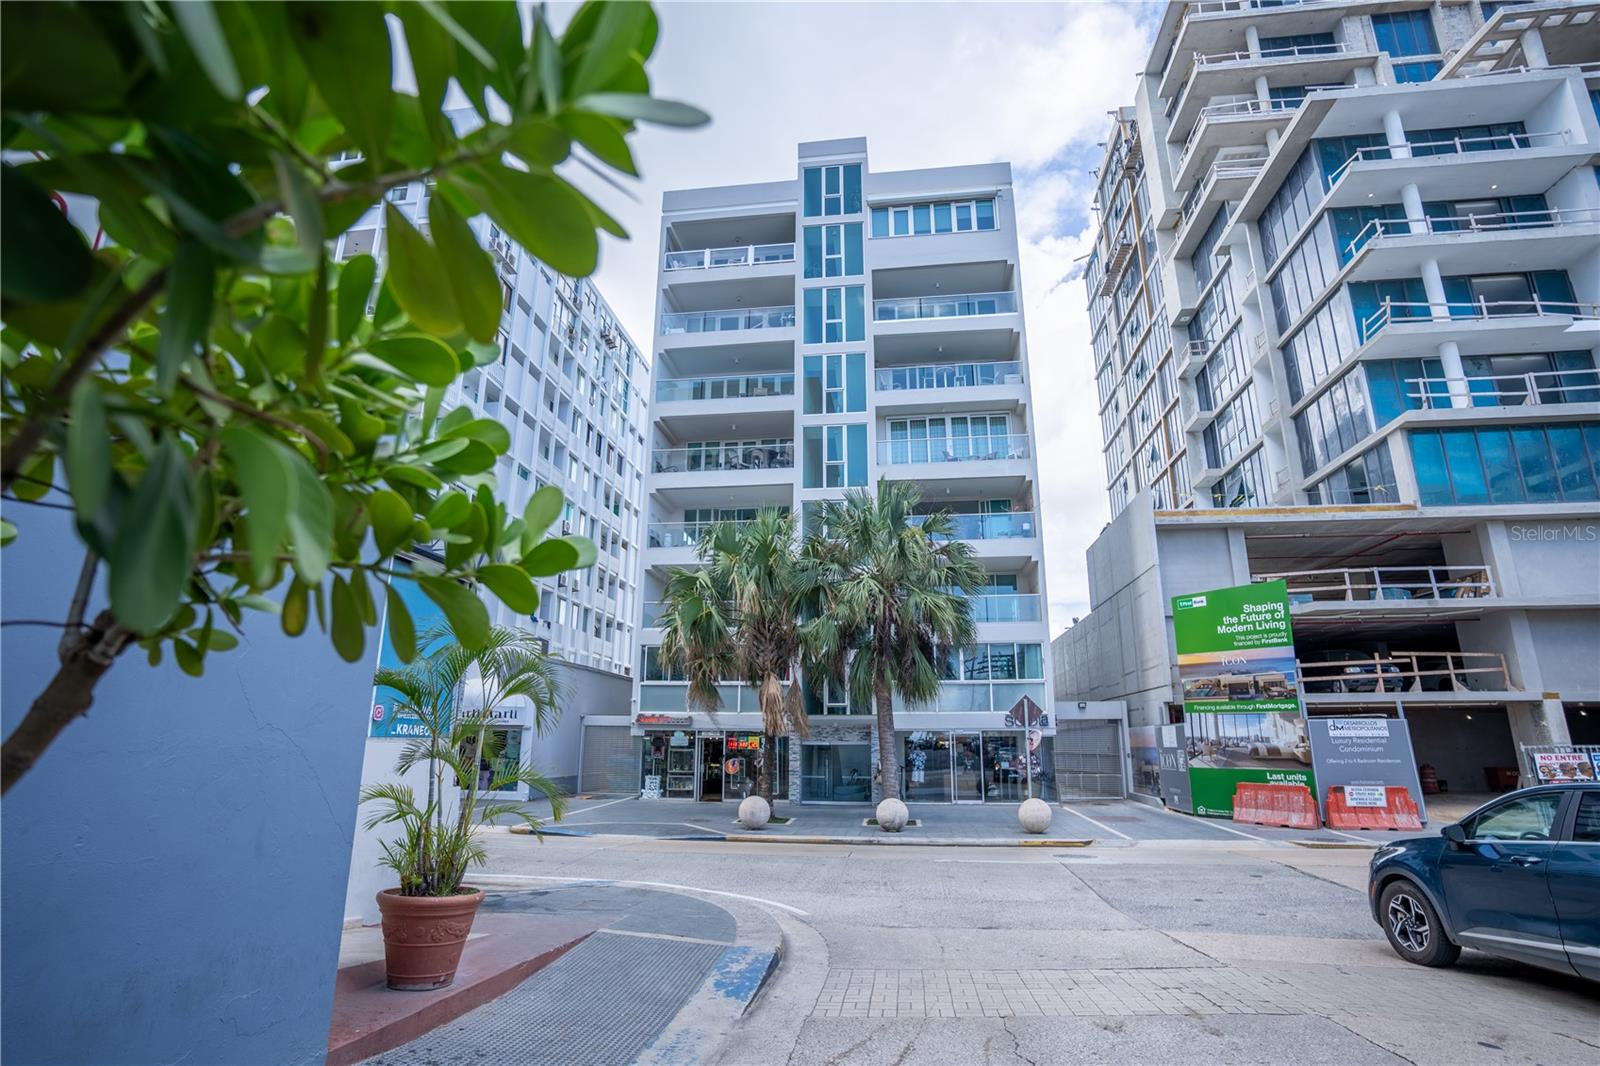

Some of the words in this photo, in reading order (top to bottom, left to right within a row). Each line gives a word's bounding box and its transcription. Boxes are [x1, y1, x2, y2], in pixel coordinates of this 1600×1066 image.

[1243, 602, 1284, 613] Shaping
[1223, 615, 1238, 625] the
[1240, 613, 1272, 623] Future
[1274, 609, 1285, 619] of
[1217, 623, 1254, 634] Modern
[1256, 620, 1286, 630] Living
[1261, 636, 1288, 644] FirstBank
[1269, 631, 1287, 639] proudly
[1220, 655, 1247, 666] ICON
[1236, 703, 1255, 711] through
[1266, 772, 1285, 781] Last
[1286, 773, 1307, 782] units
